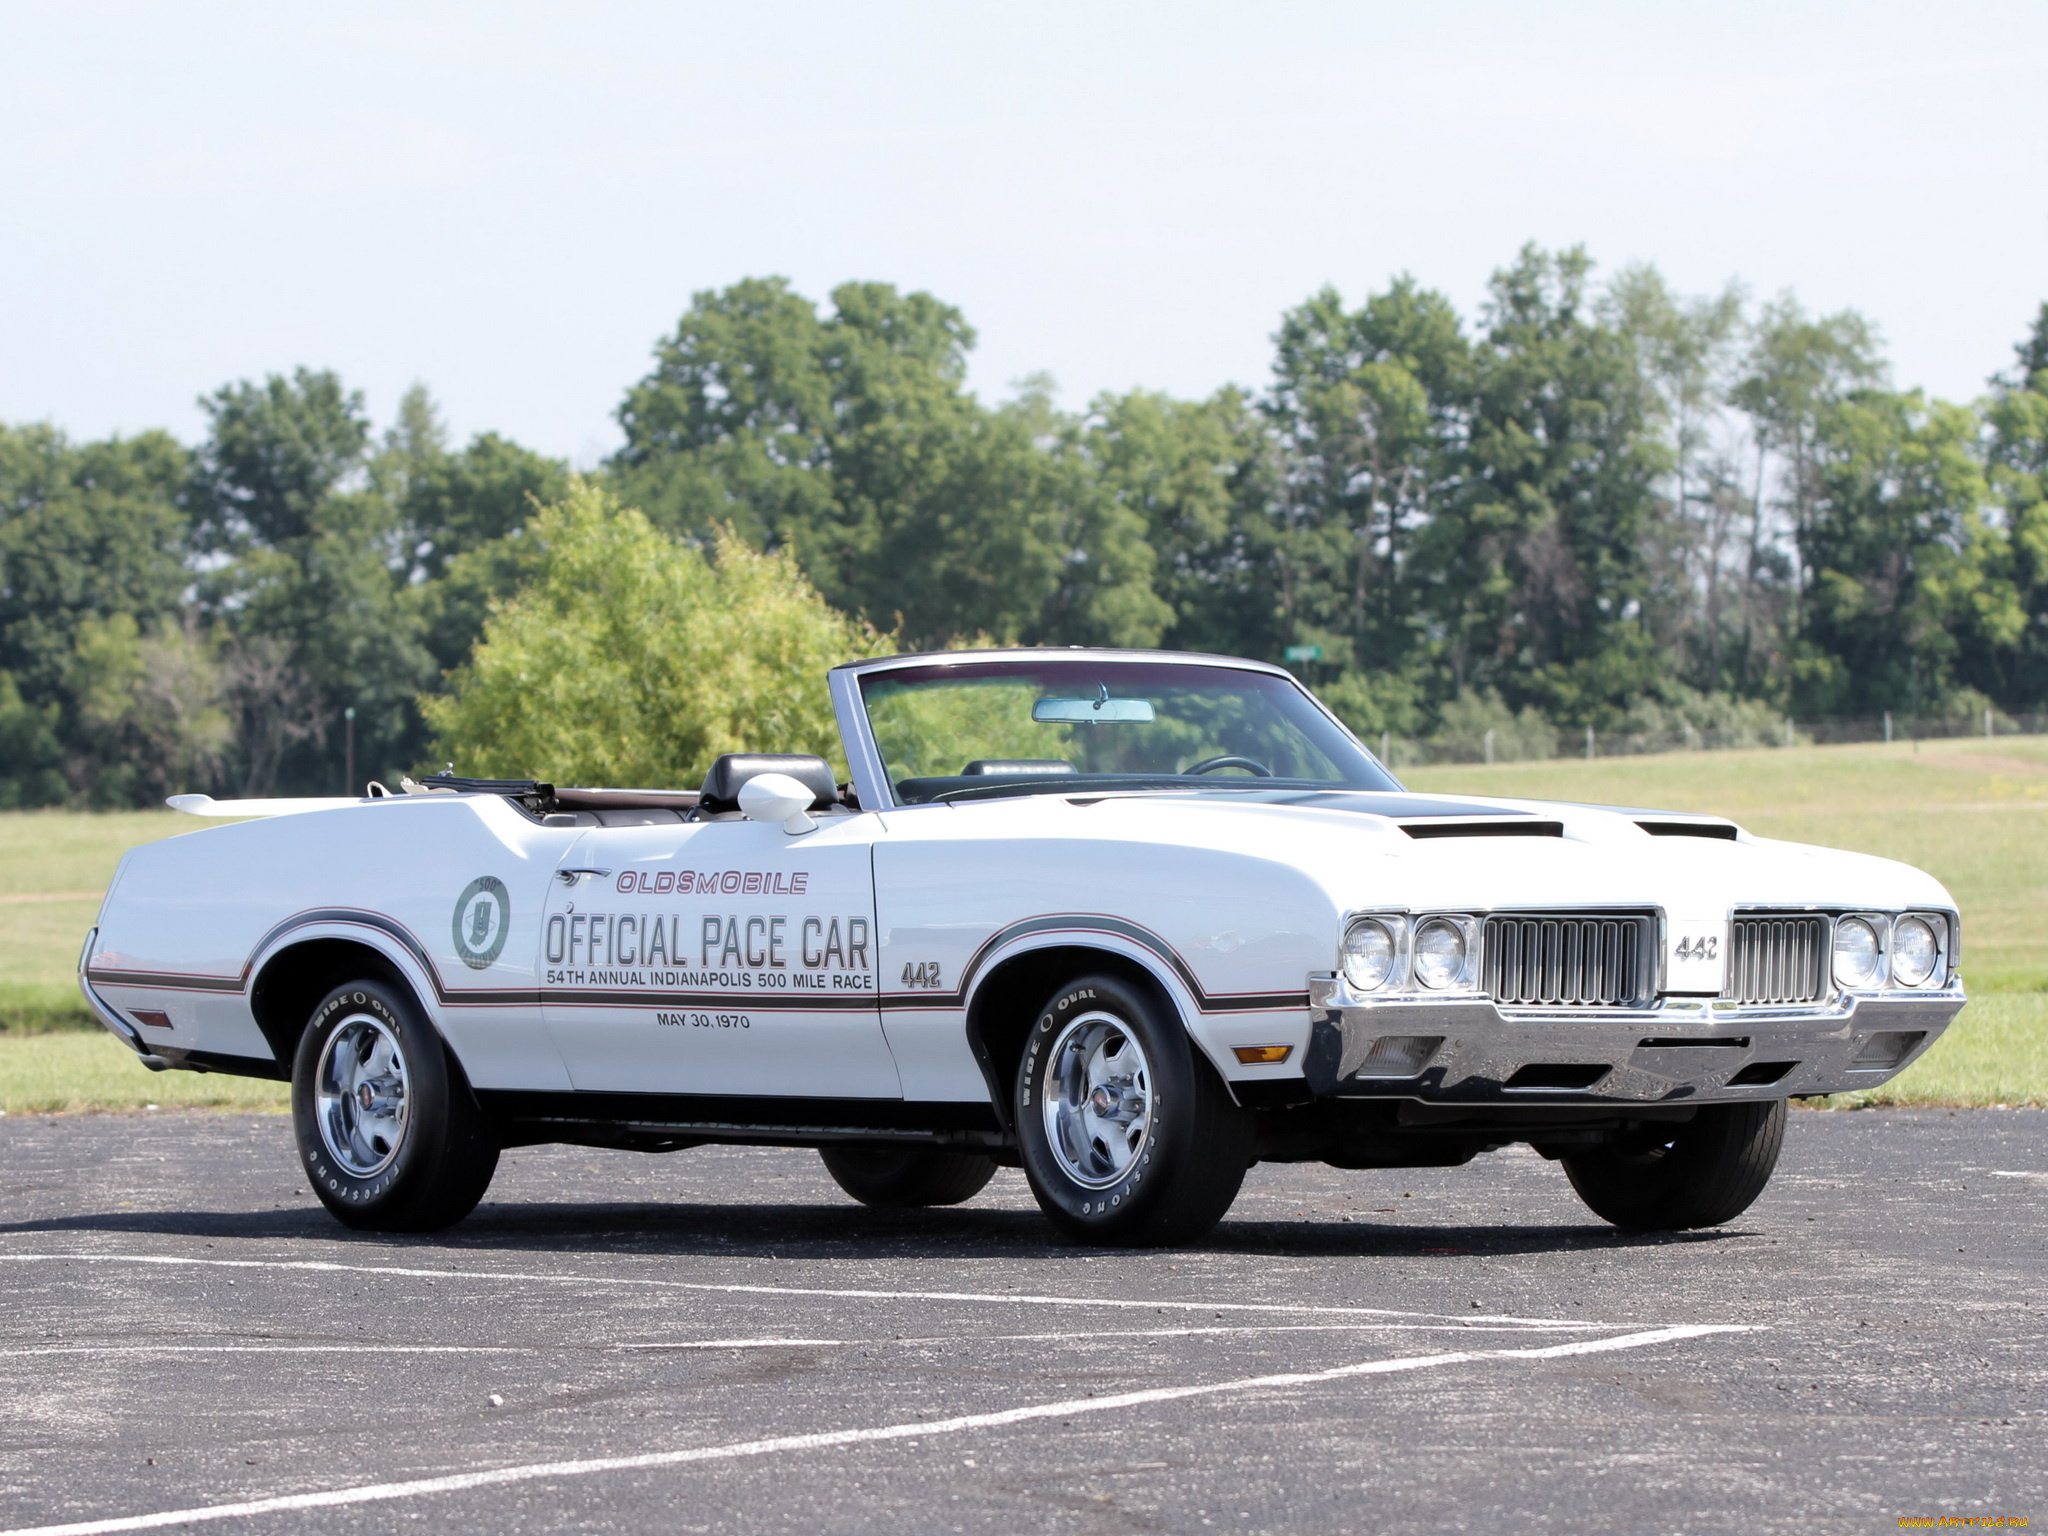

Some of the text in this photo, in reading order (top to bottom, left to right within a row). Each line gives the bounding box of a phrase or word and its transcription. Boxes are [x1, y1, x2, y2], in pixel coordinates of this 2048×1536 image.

[616, 871, 809, 895] OLDSMOBILE
[545, 913, 870, 971] OFFICIAL PACE CAR
[1674, 936, 1718, 960] 442
[546, 970, 873, 989] 54TH ANNUAL INDIANAPOLIS 500 MILE RACE
[901, 961, 941, 988] 442
[314, 995, 349, 1028] WIDE
[371, 999, 402, 1037] OVAL
[657, 1013, 686, 1026] MAY
[1023, 1039, 1041, 1107] WIDE
[1057, 989, 1097, 1011] OVAL
